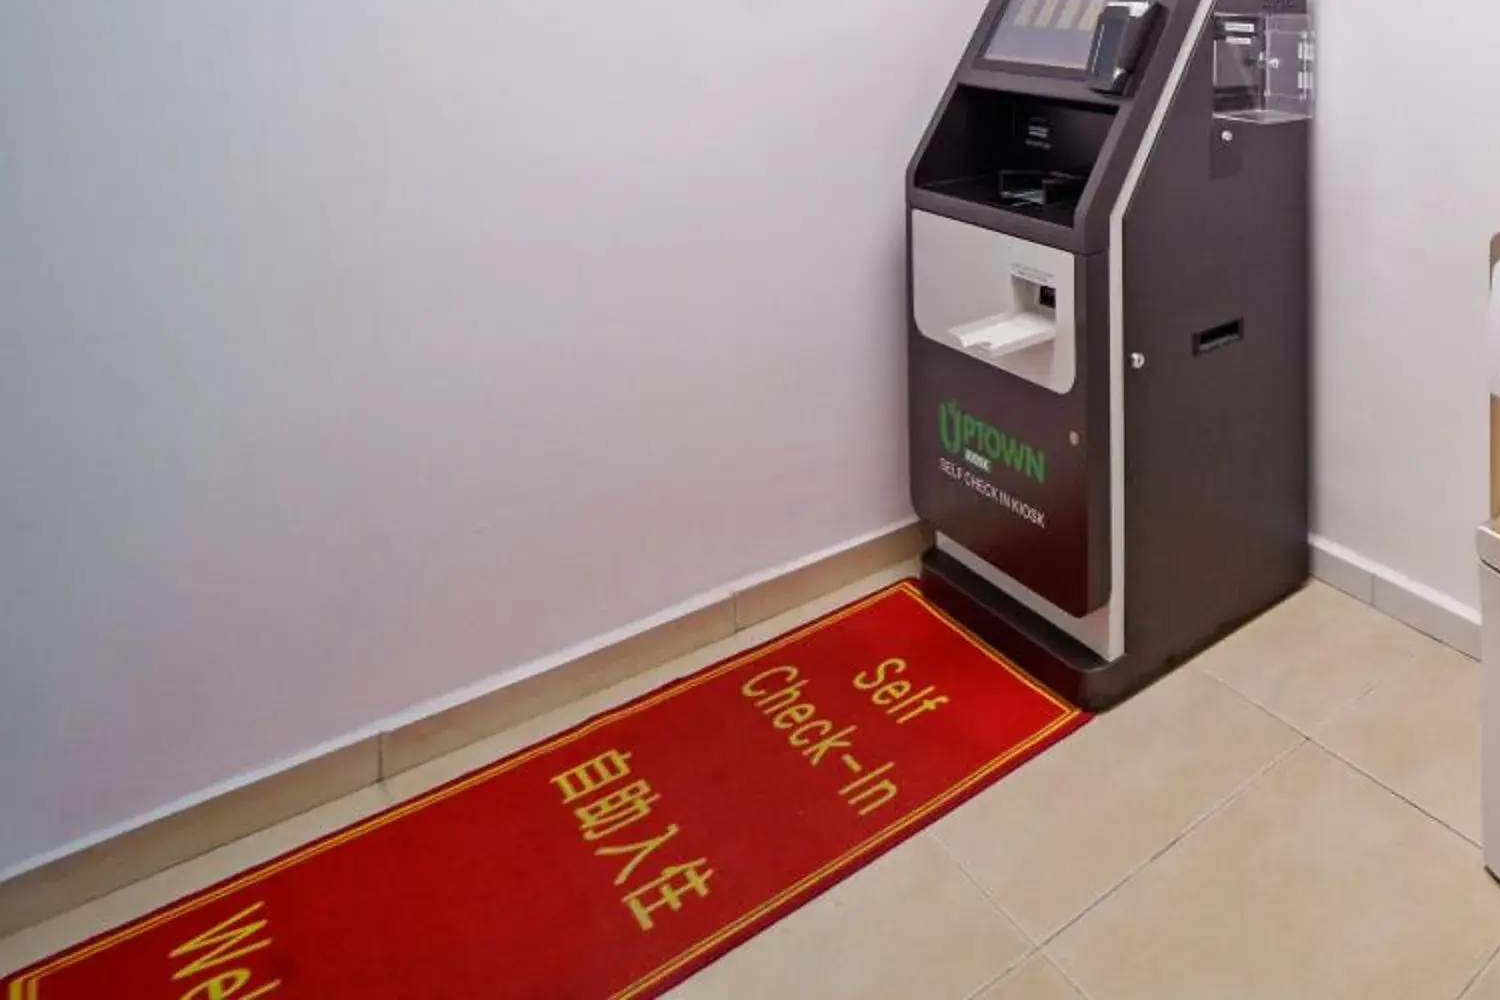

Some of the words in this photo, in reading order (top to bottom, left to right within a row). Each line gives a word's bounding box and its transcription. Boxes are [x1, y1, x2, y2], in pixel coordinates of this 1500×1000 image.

[940, 399, 1044, 483] UPTOWN
[939, 457, 961, 480] SELF
[964, 470, 998, 501] CHECK
[999, 489, 1011, 508] IN
[1011, 497, 1045, 529] KIOSK
[853, 657, 949, 724] Self
[741, 665, 897, 816] Check-In
[550, 748, 714, 931] 自助入住
